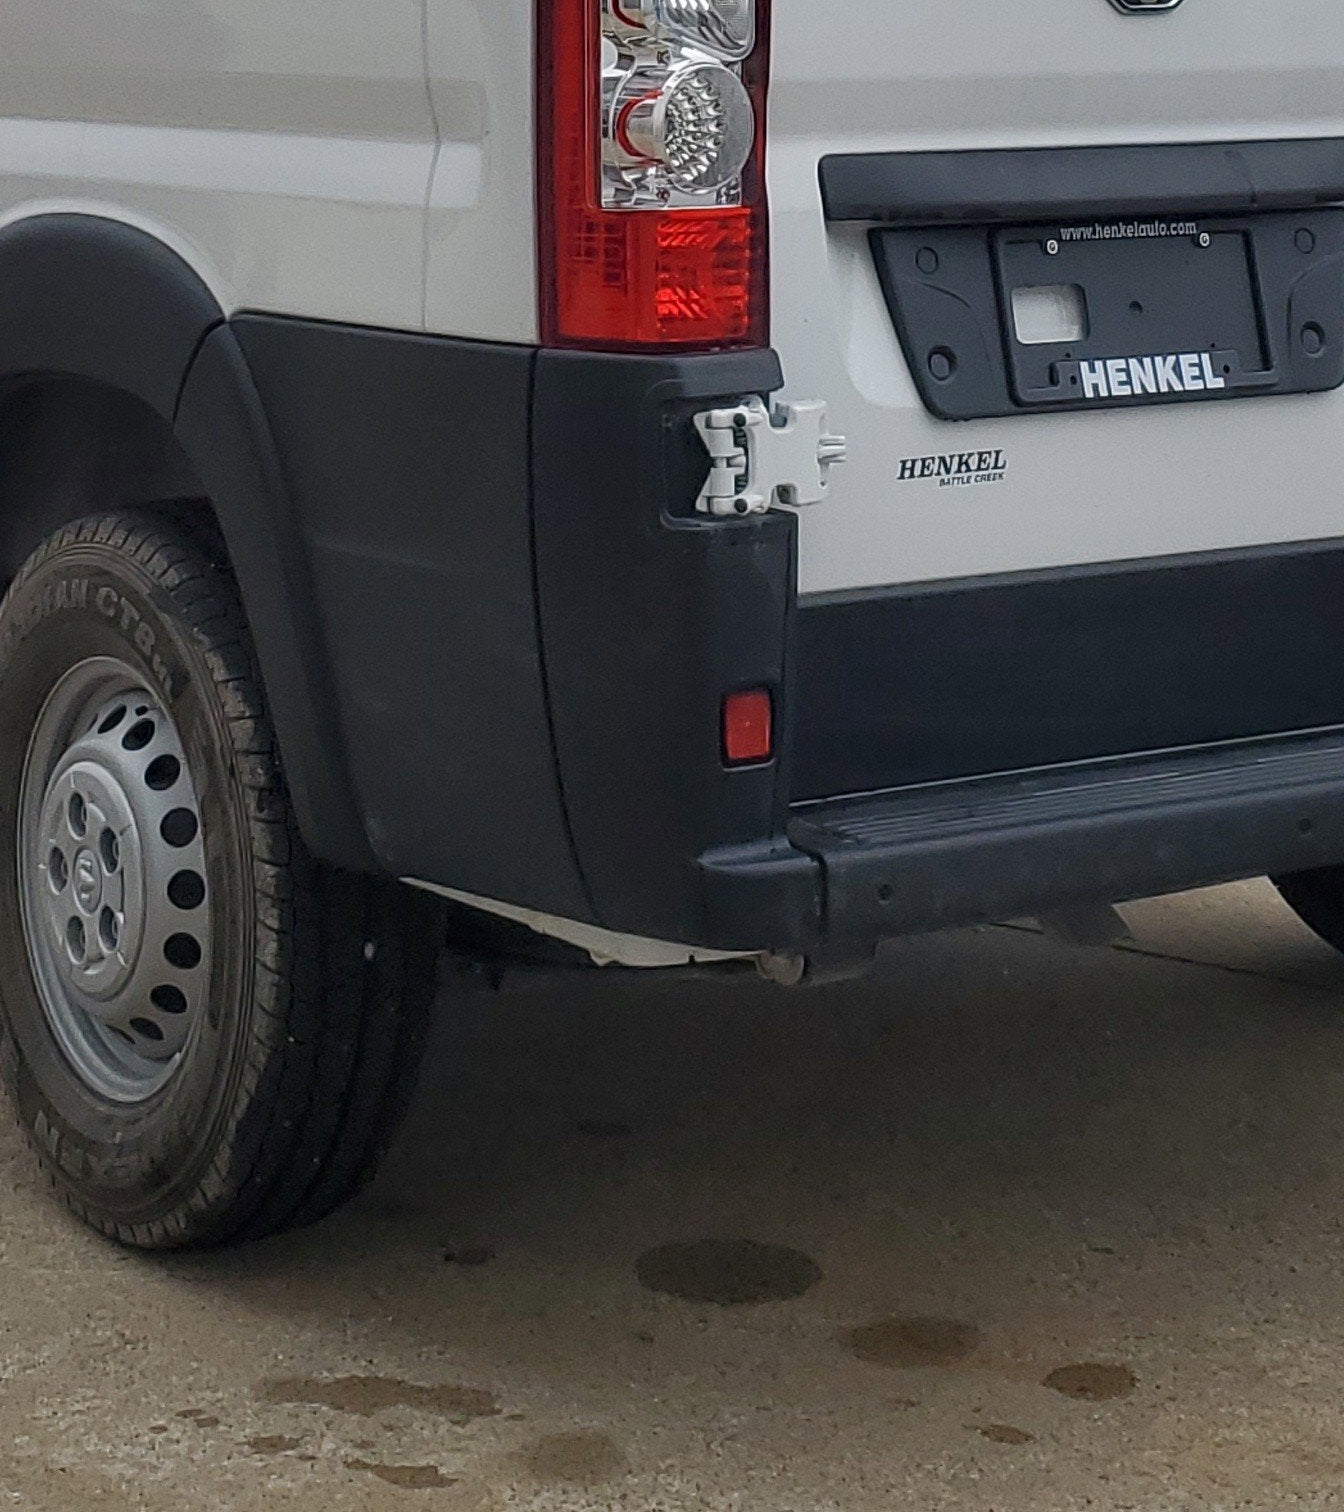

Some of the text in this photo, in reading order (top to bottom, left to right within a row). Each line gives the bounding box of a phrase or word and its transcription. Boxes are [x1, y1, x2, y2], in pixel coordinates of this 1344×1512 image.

[1060, 220, 1197, 240] www.henkelauto.com
[1079, 352, 1225, 398] HENKEL
[896, 449, 1007, 480] HENKEL
[939, 472, 1005, 487] BATTLE CREEK
[96, 586, 155, 656] CT8
